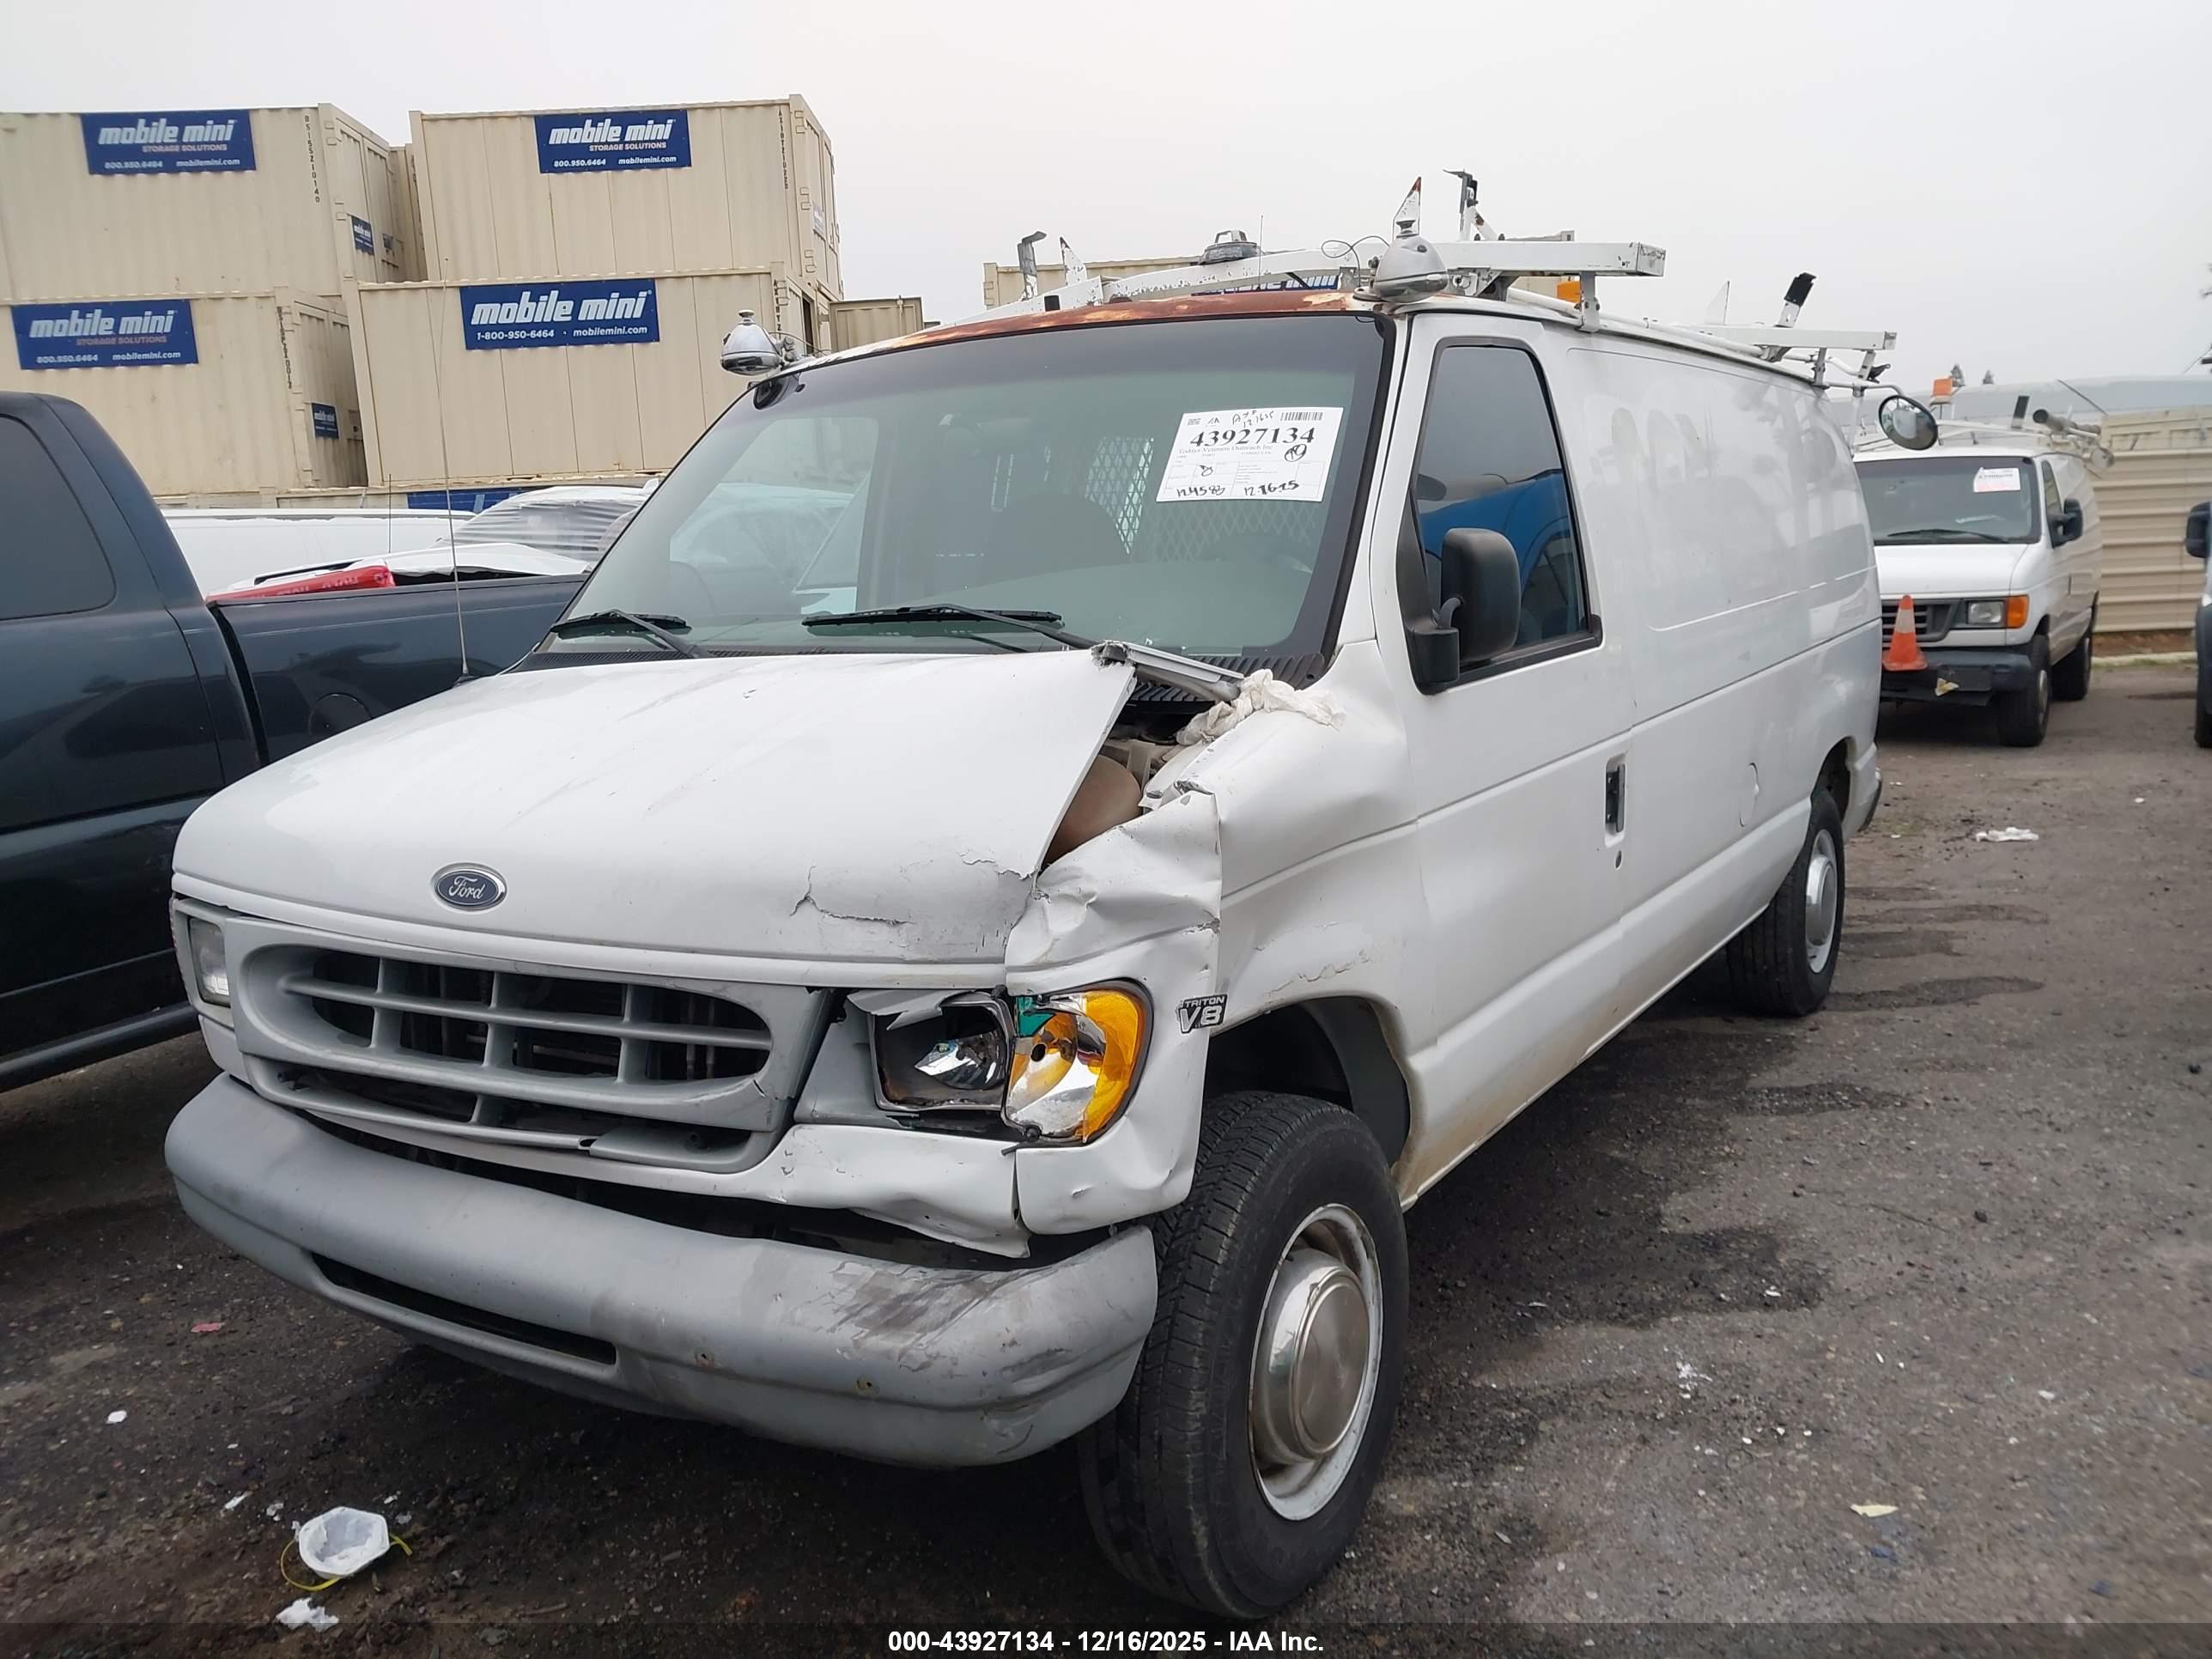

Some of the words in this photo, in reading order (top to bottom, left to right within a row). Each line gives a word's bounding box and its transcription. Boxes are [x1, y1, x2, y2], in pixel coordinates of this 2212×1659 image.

[99, 118, 179, 145] mobile
[182, 119, 234, 143] mini
[549, 118, 623, 145] mobile
[624, 118, 674, 142] mini
[142, 144, 179, 153] STORAGE
[181, 143, 228, 152] SOLUTIONS
[589, 143, 624, 152] STORAGE
[624, 142, 667, 150] SOLUTIONS
[176, 158, 240, 167] mobilemini.com
[554, 158, 606, 167] 800.950.6464
[618, 155, 677, 165] mobilemini.com
[471, 290, 574, 325] mobile
[578, 291, 647, 321] mini
[29, 309, 116, 338] mobile
[118, 310, 175, 335] mini
[118, 336, 167, 344] SOLUTIONS
[477, 329, 555, 341] 1-800-950-6464
[573, 326, 647, 337] mobilemini.com
[112, 351, 181, 361] mobilemini.com
[1190, 427, 1316, 447] 43927134
[448, 876, 485, 899] Ford
[1185, 996, 1225, 1007] TRITON
[1180, 1006, 1223, 1032] V8
